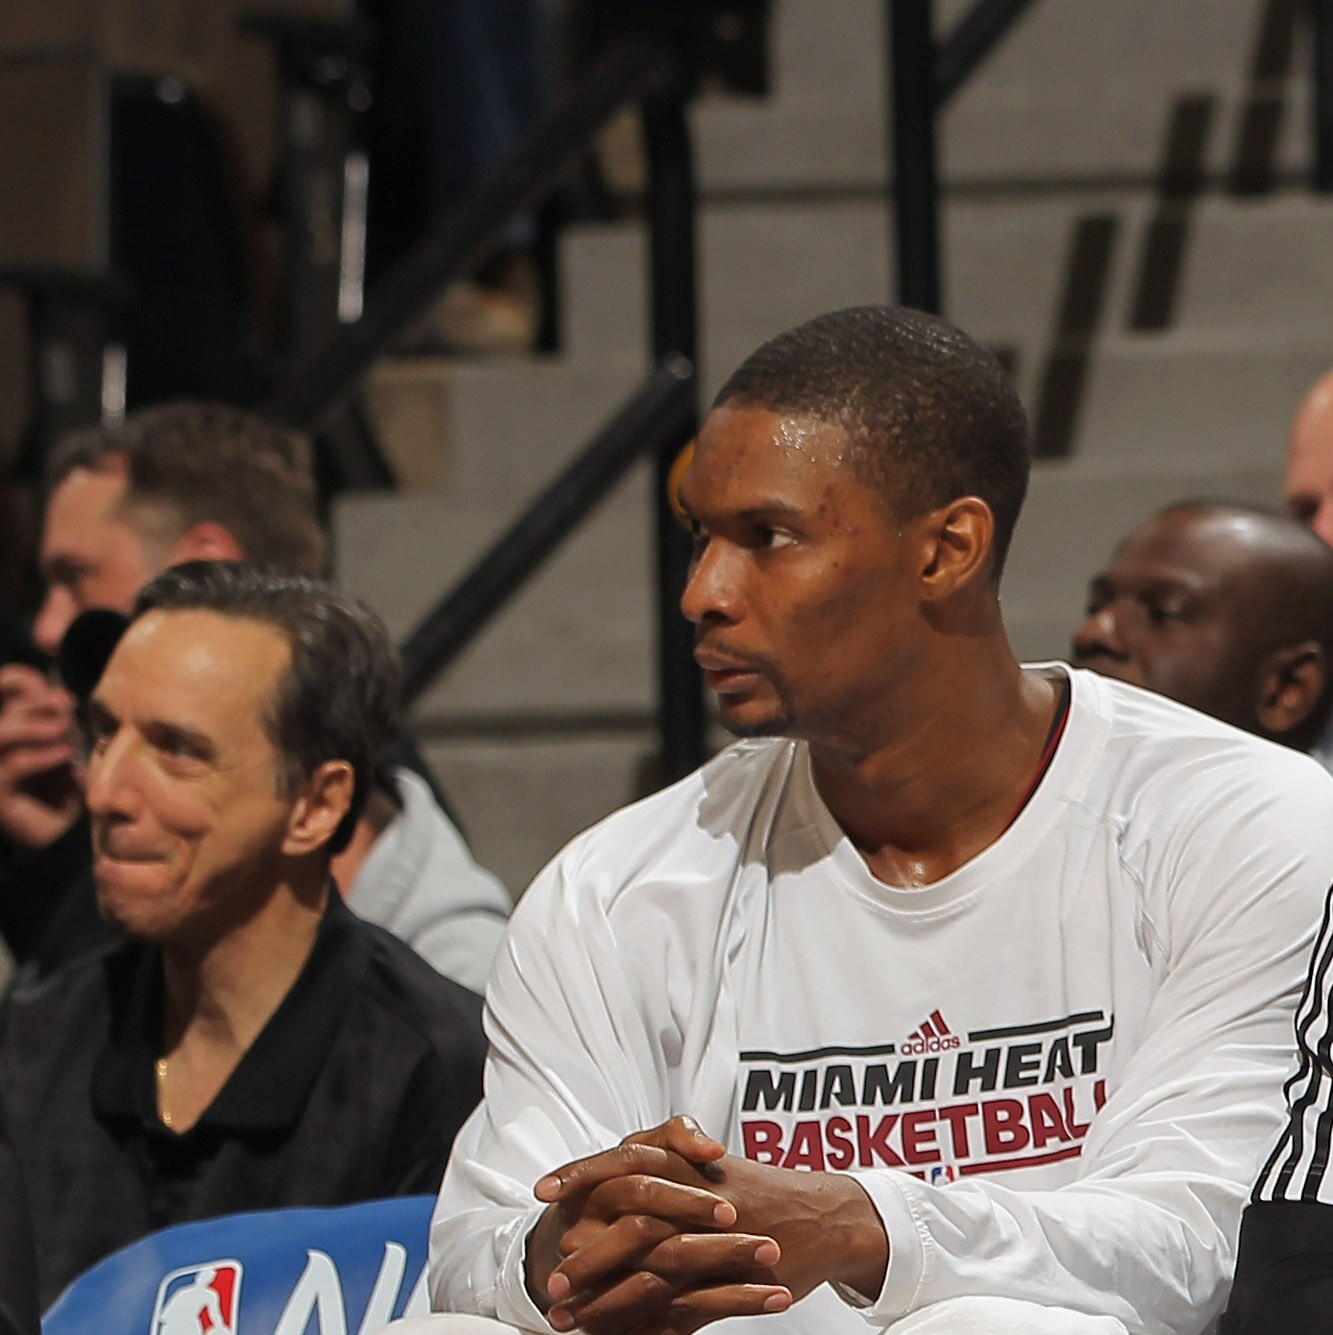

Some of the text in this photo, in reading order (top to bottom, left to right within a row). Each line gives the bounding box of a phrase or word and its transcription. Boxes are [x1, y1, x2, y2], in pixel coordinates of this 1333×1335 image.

[741, 1028, 1114, 1113] MIAMI HEAT
[901, 1036, 961, 1057] adidas
